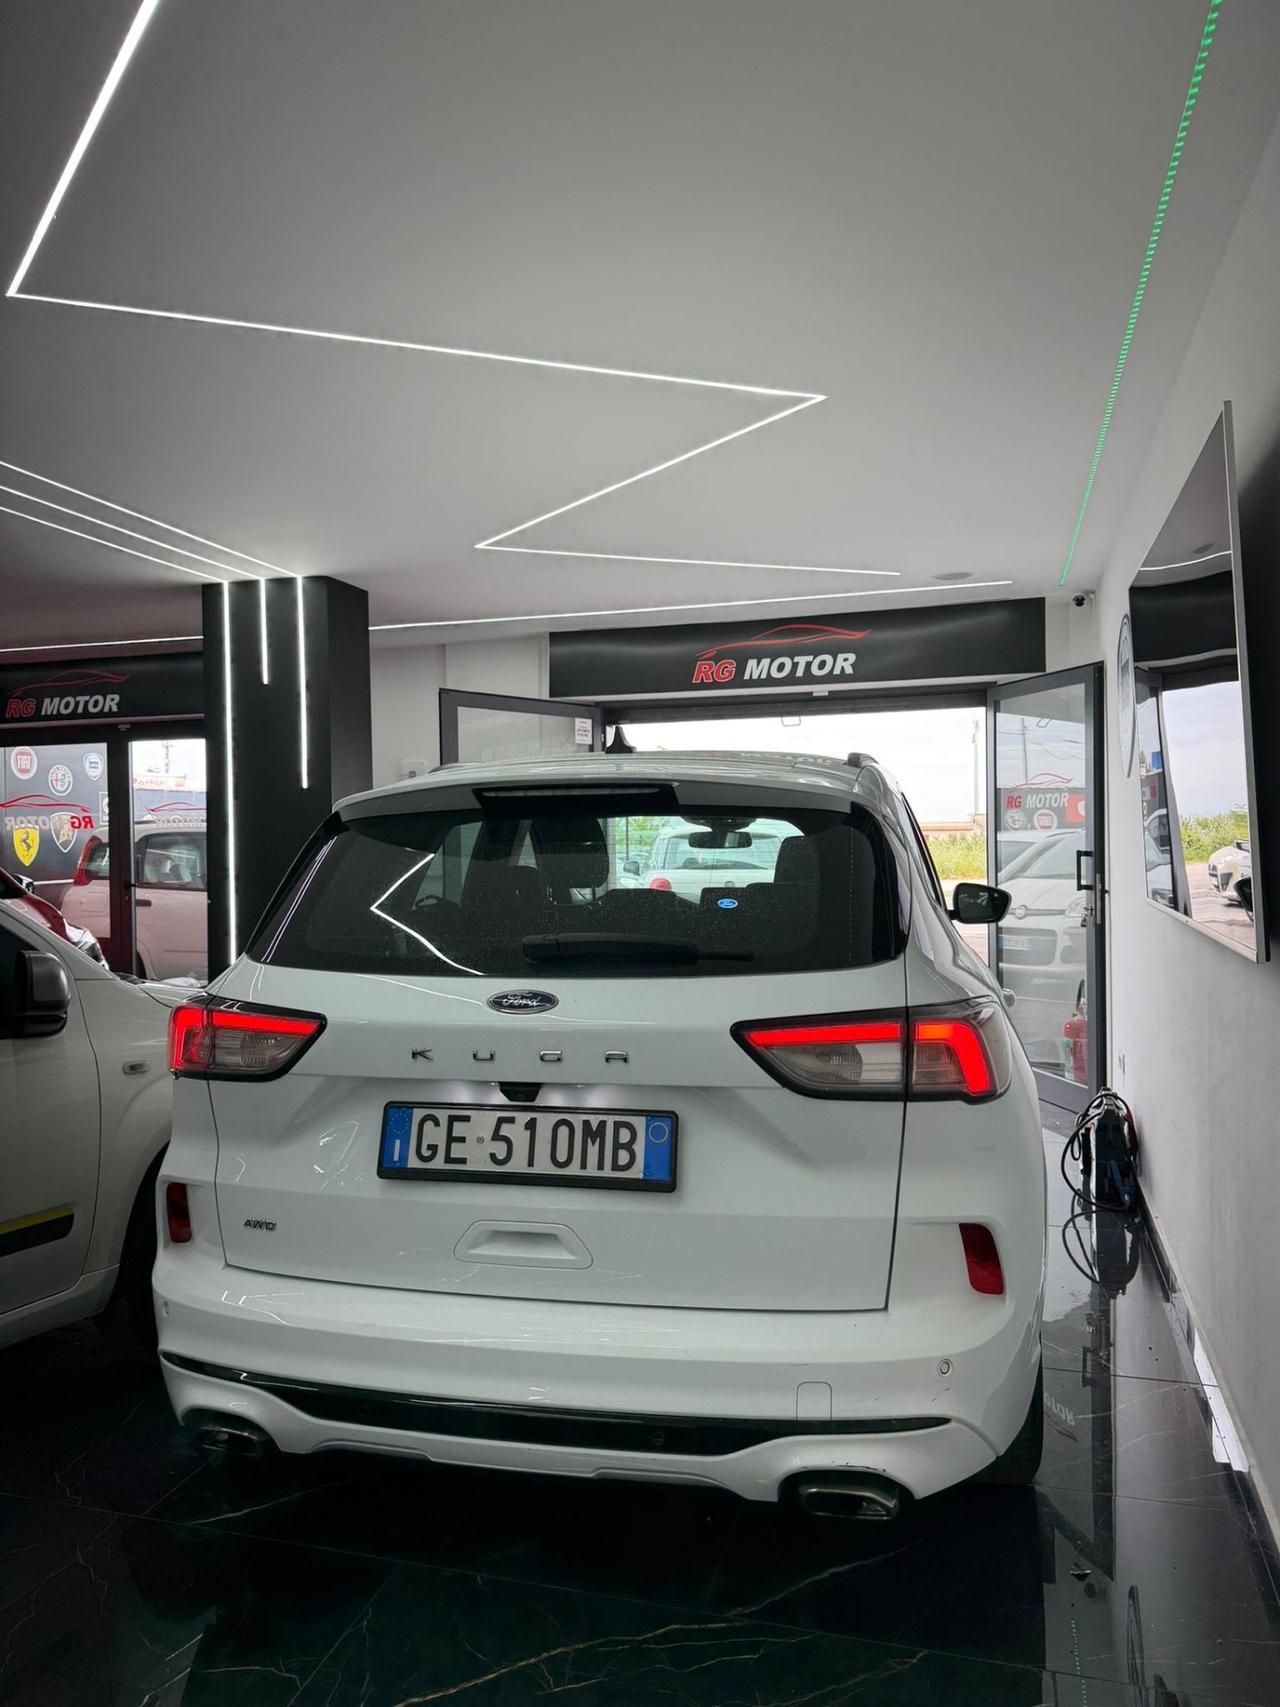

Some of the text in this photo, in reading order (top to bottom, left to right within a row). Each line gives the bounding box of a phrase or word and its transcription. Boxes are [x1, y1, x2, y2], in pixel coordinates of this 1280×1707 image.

[692, 653, 856, 684] RG MOTOR
[5, 694, 120, 718] RG MOTOR
[1006, 792, 1069, 808] RG MOTOR
[502, 992, 551, 1007] Ford
[411, 1049, 628, 1063] KUGA
[415, 1113, 637, 1172] GE 510MB
[243, 1219, 277, 1231] AWD
